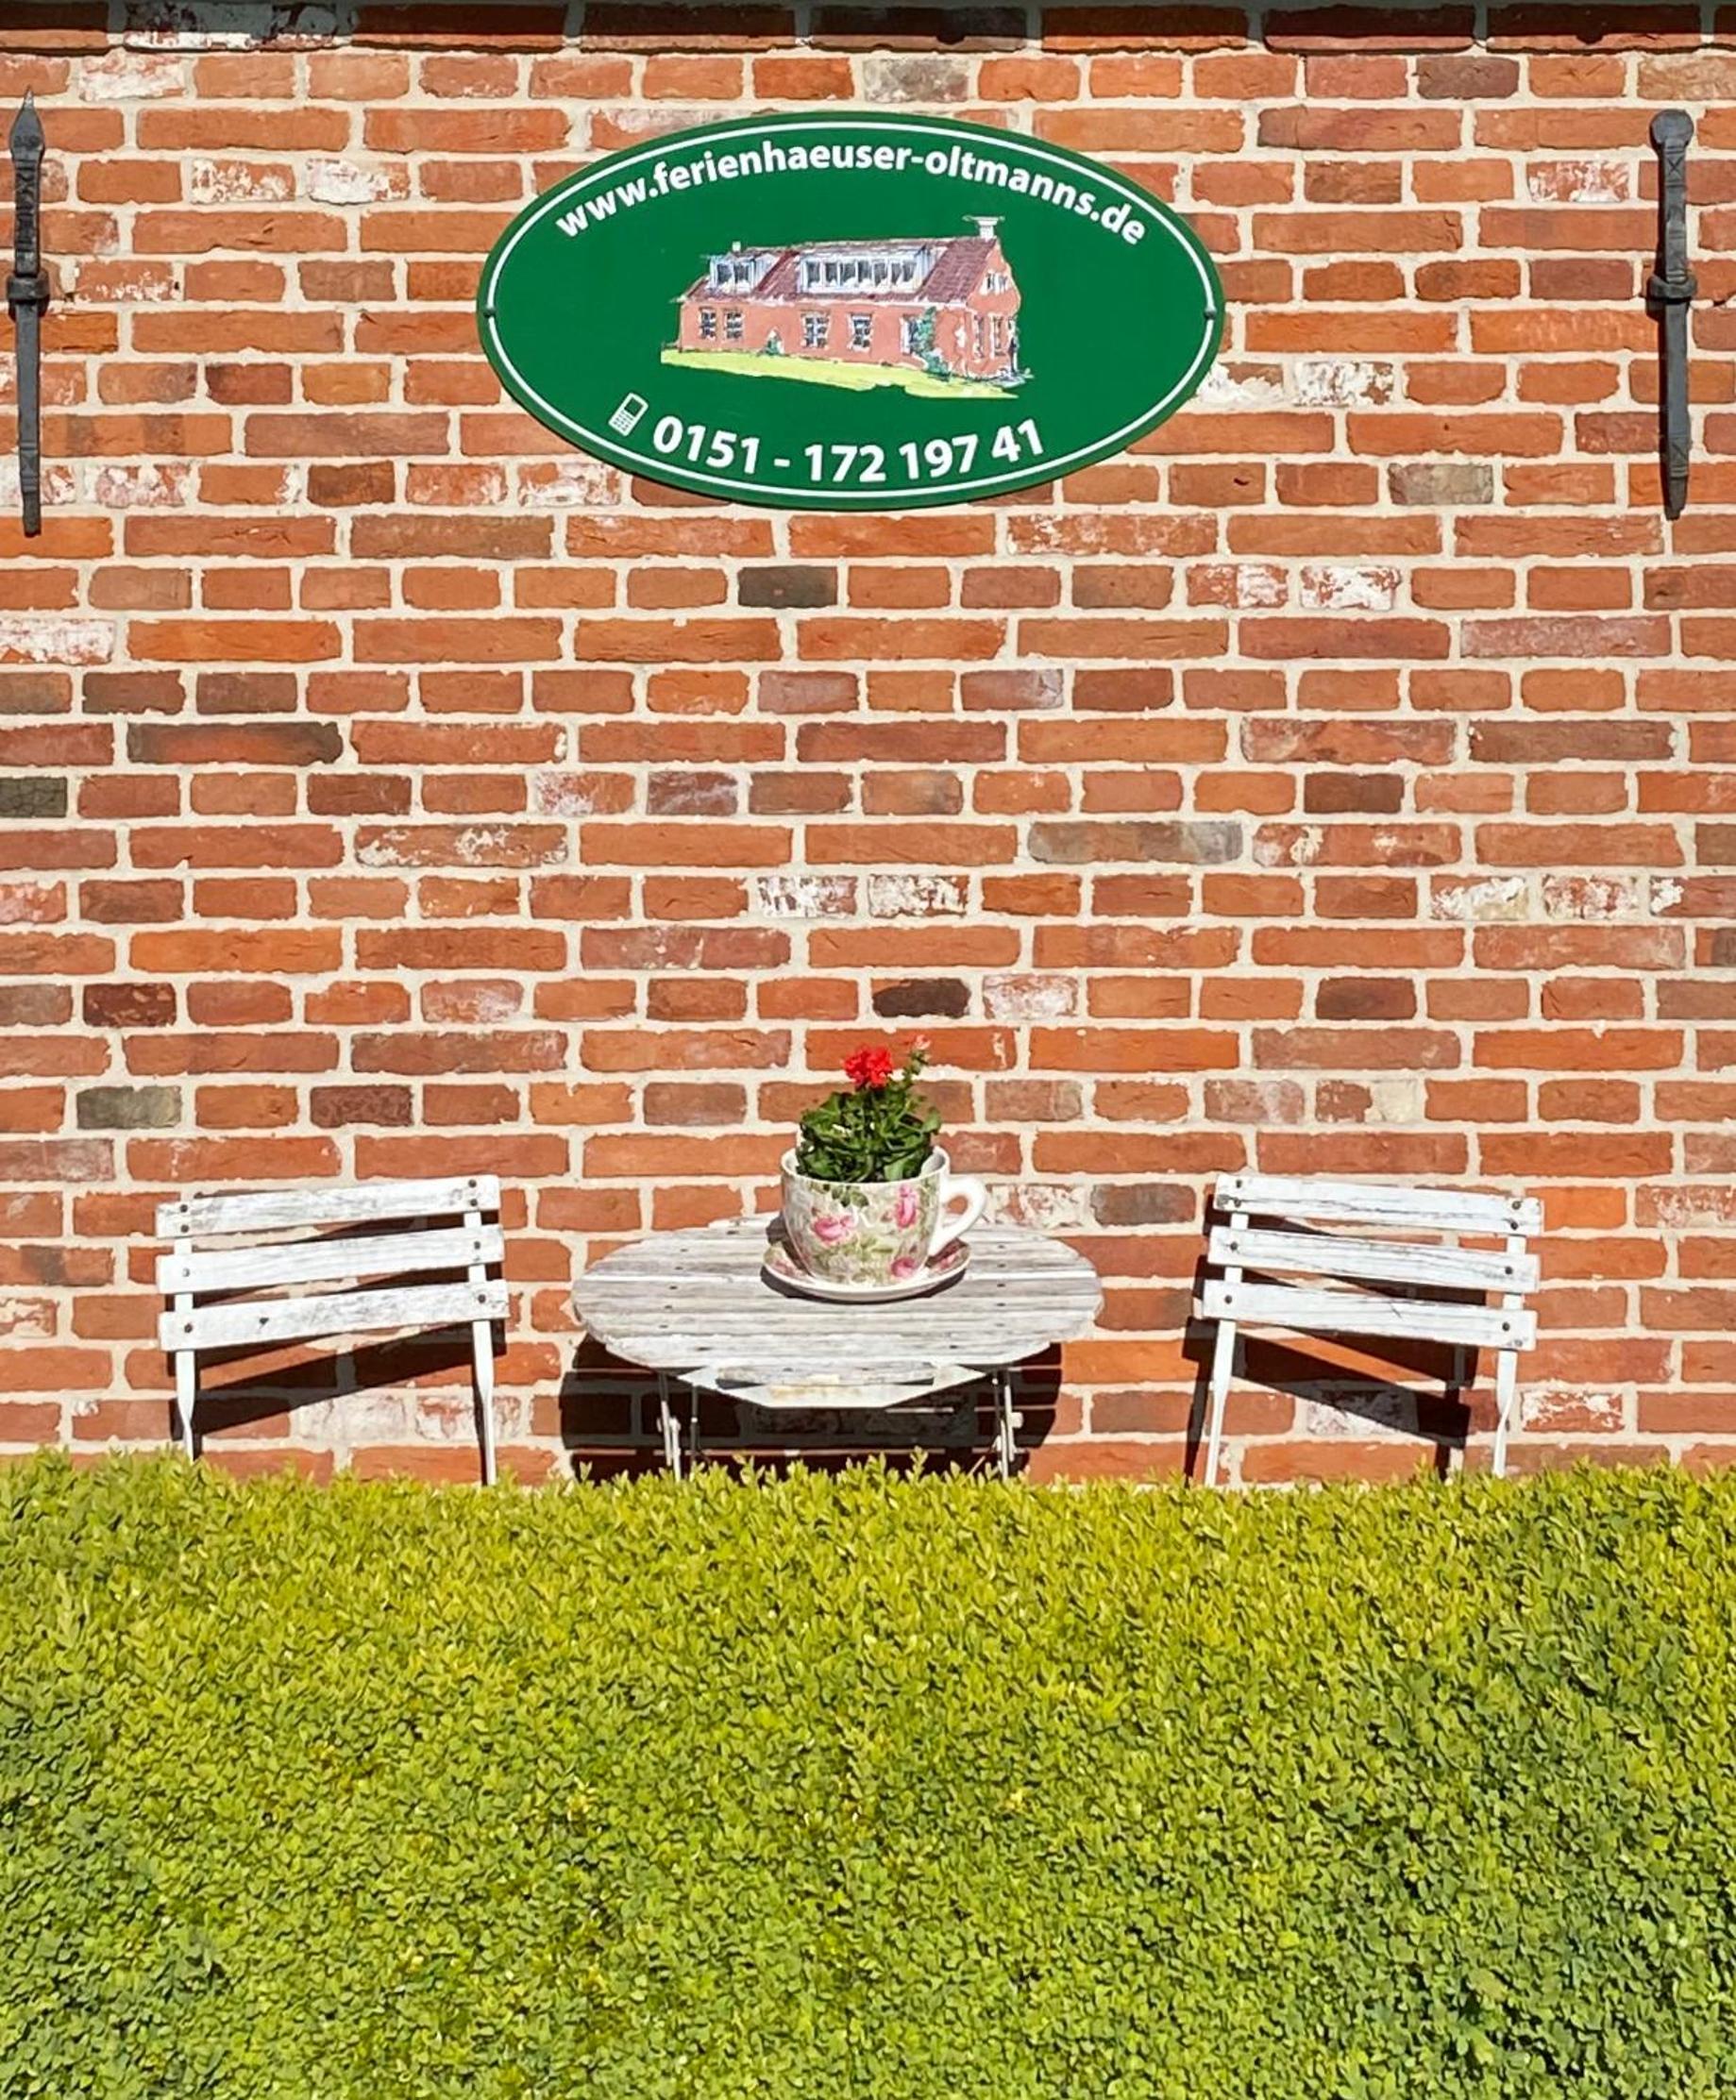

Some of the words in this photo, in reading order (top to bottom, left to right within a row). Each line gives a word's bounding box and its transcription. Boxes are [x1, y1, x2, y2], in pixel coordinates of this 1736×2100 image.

[555, 139, 1145, 244] www.ferienhaeuser-oltmanns.de
[653, 415, 760, 474] 0151
[774, 458, 790, 467] -
[804, 444, 886, 482] 172
[899, 433, 979, 479] 197
[991, 419, 1044, 462] 41
